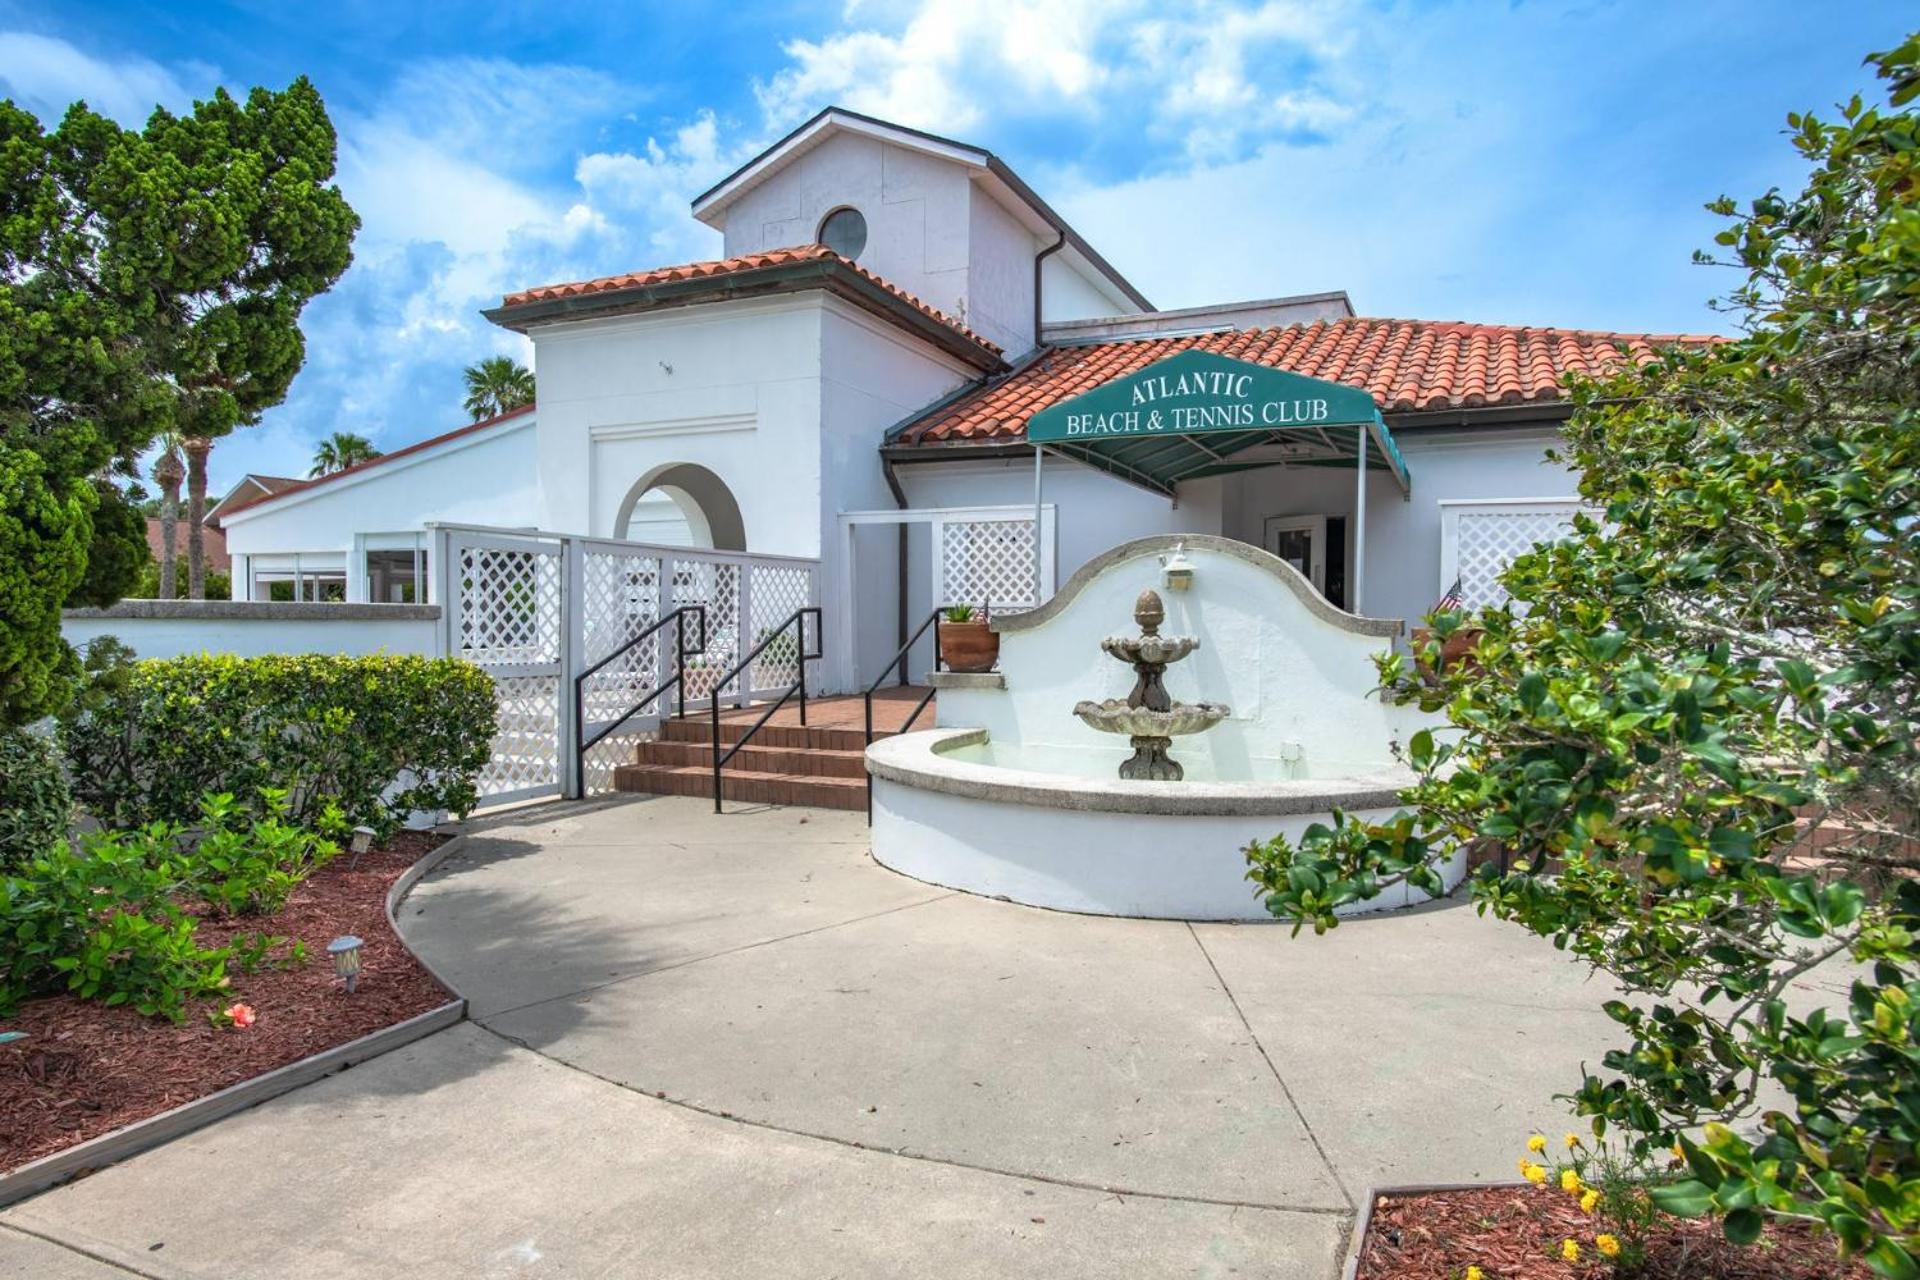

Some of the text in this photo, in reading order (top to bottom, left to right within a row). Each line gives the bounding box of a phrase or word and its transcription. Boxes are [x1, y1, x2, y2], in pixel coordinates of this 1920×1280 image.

[1132, 372, 1253, 406] ATLANTIC
[1066, 399, 1328, 435] BEACH & TENNIS CLUB
